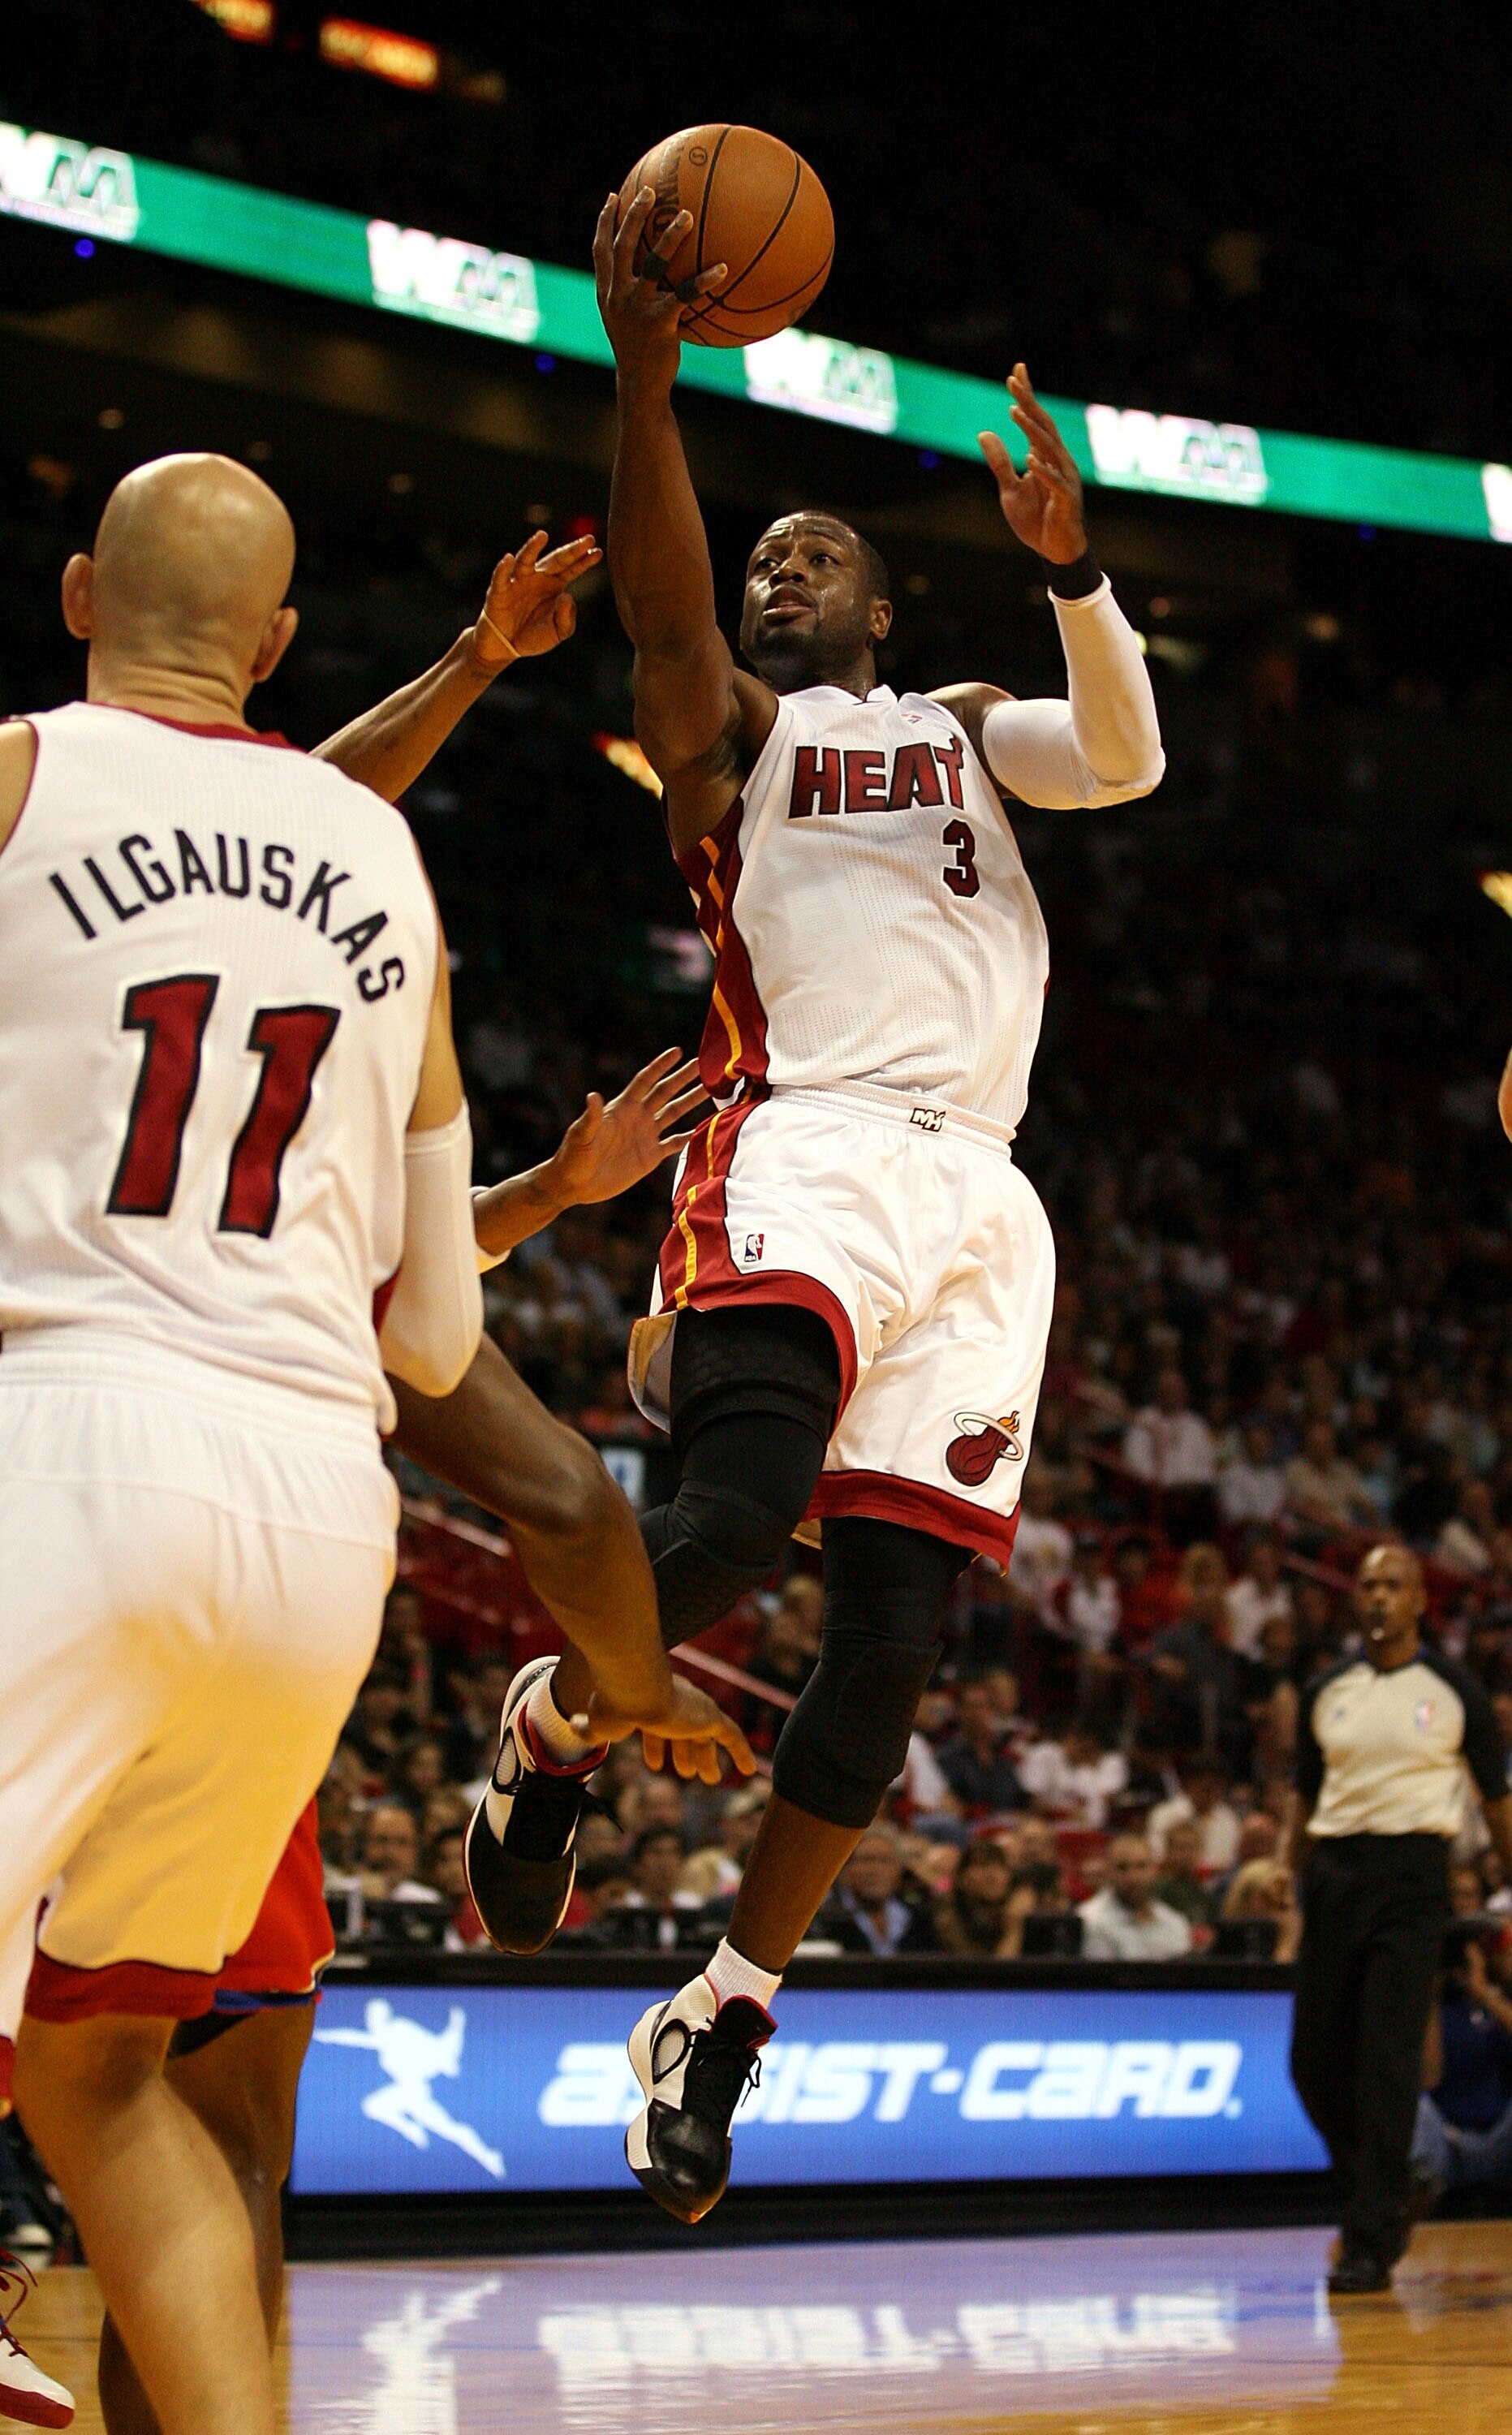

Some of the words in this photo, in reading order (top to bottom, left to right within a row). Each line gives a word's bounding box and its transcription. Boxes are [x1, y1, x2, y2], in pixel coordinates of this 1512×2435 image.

[788, 734, 963, 819] HEAT
[48, 829, 406, 1003] ILGAUSKAS
[942, 818, 980, 899] 3
[106, 973, 342, 1239] 11
